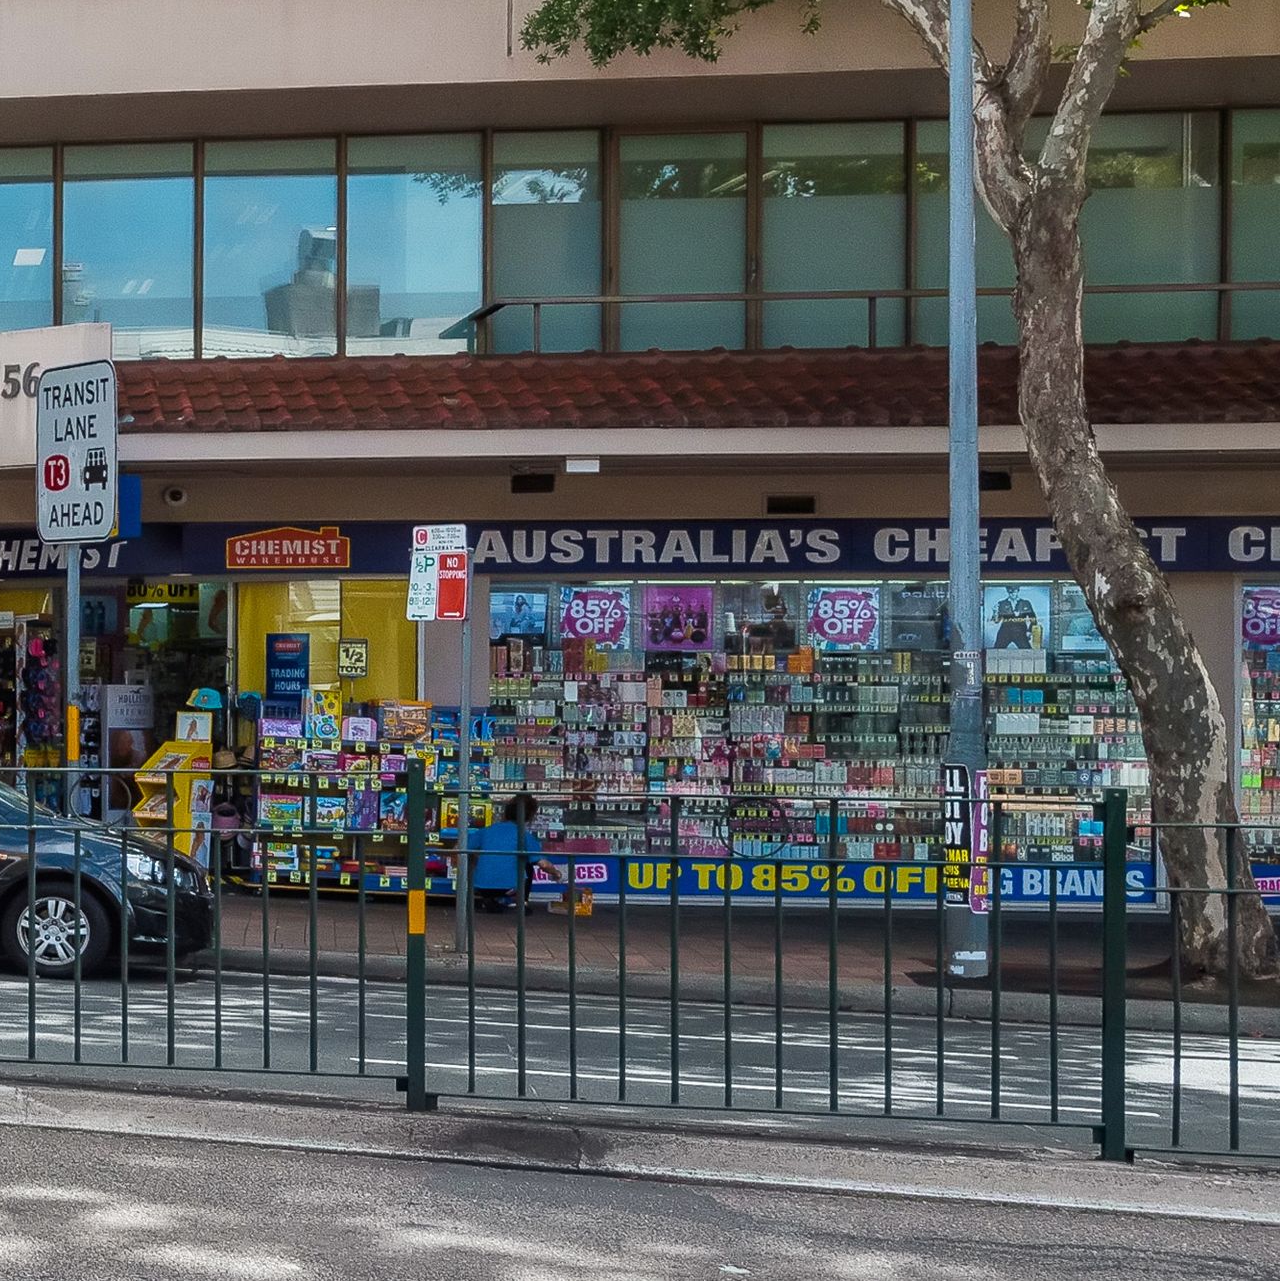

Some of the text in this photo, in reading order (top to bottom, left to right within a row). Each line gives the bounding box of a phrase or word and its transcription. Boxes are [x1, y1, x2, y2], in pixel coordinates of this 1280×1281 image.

[43, 377, 109, 410] TRANSIT
[54, 414, 97, 443] LANE
[48, 458, 66, 487] T3
[48, 501, 104, 528] AHEAD
[234, 539, 341, 556] CHEMIST
[472, 529, 841, 564] AUSTRALIA'S
[1228, 526, 1280, 562] C
[236, 556, 341, 564] WAREHOUSE
[446, 557, 459, 568] NO
[439, 570, 466, 579] STOPPING
[570, 599, 621, 619] 85%
[818, 599, 872, 619] 85%
[575, 618, 615, 635] OFF
[823, 619, 865, 635] OFF
[1246, 618, 1280, 635] OF
[270, 668, 306, 679] TRADING
[340, 665, 367, 674] TOYS
[274, 680, 301, 691] HOURS
[627, 862, 682, 890] UP
[691, 863, 743, 891] TO
[751, 864, 856, 893] 85%
[1022, 868, 1145, 897] BRANS
